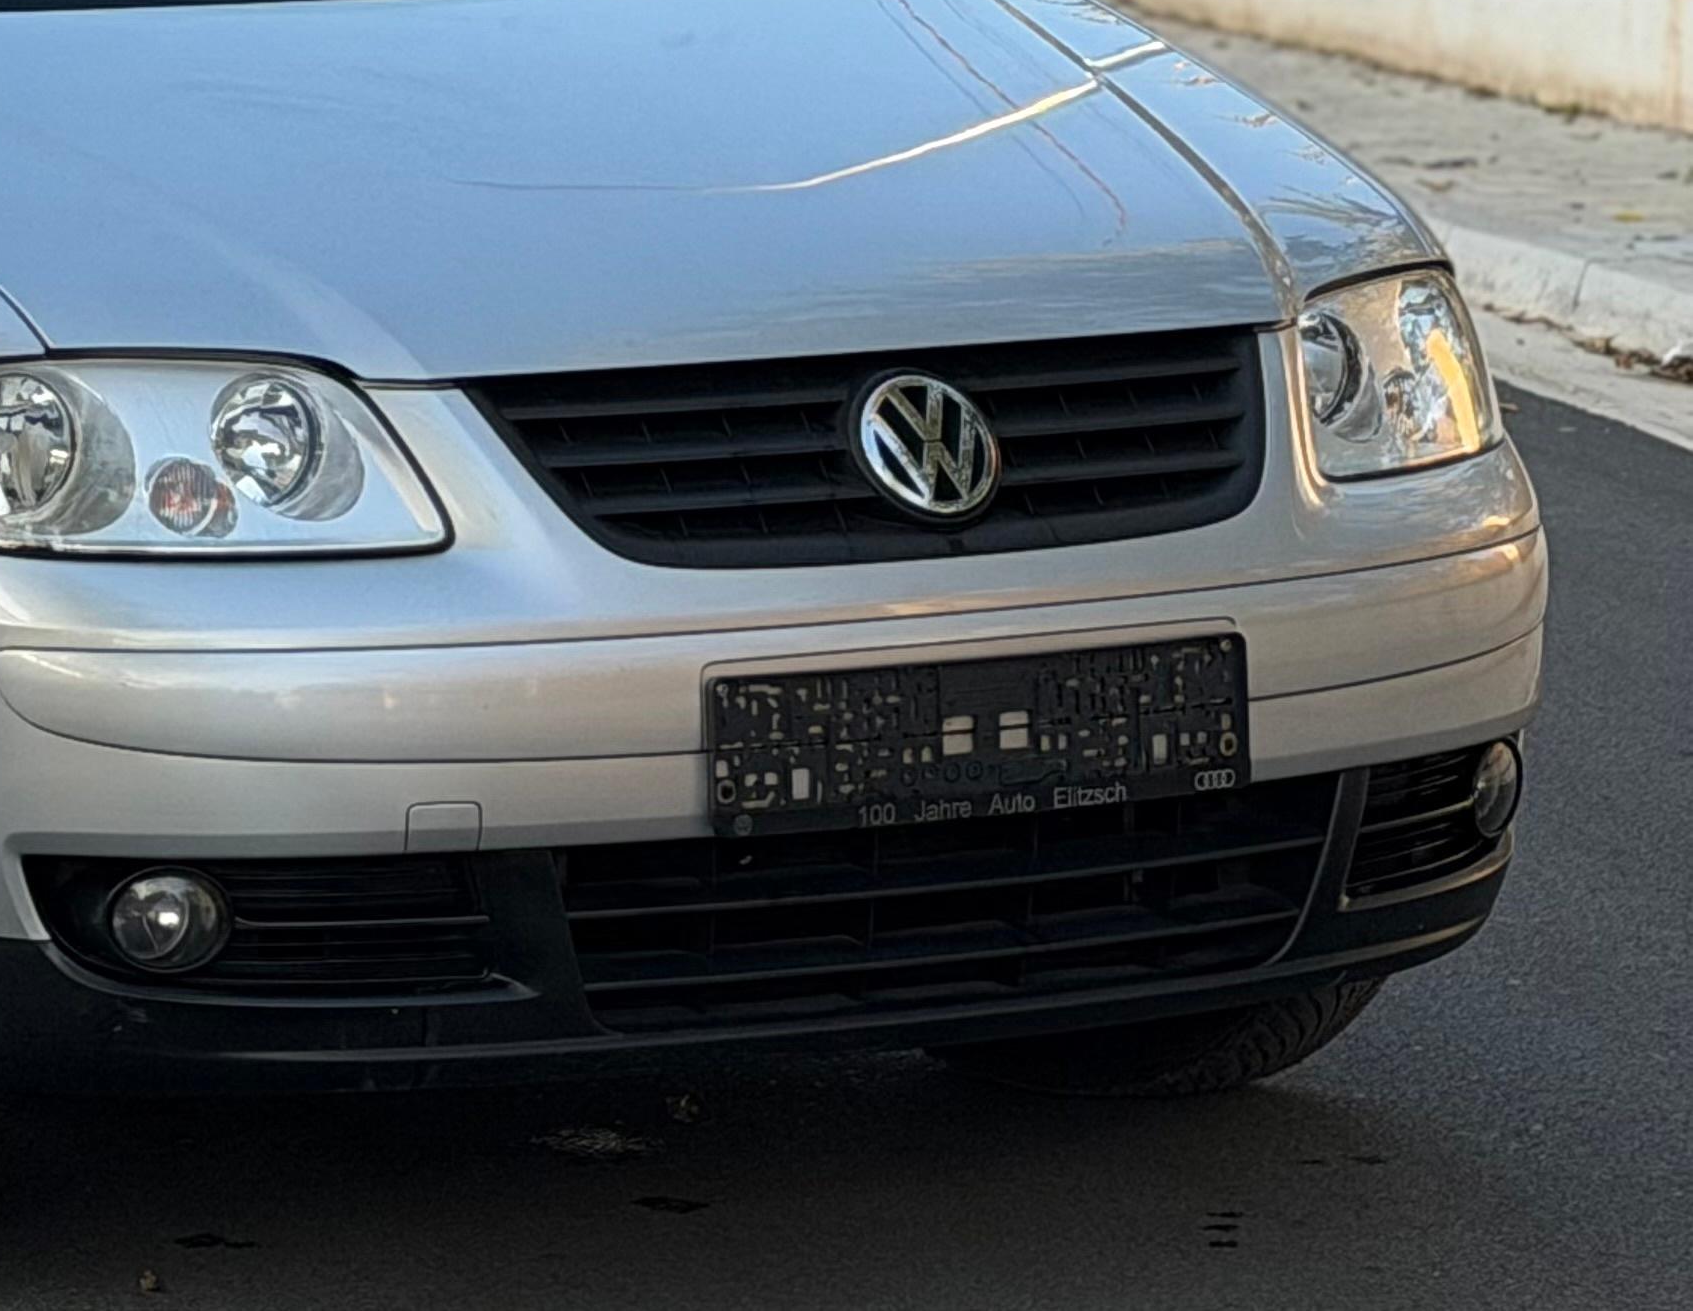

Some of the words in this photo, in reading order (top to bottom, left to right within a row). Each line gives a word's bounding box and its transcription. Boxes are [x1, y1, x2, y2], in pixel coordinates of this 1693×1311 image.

[861, 375, 1001, 514] VW
[857, 802, 897, 828] 100
[914, 798, 973, 823] Jahre
[987, 792, 1037, 816] Auto
